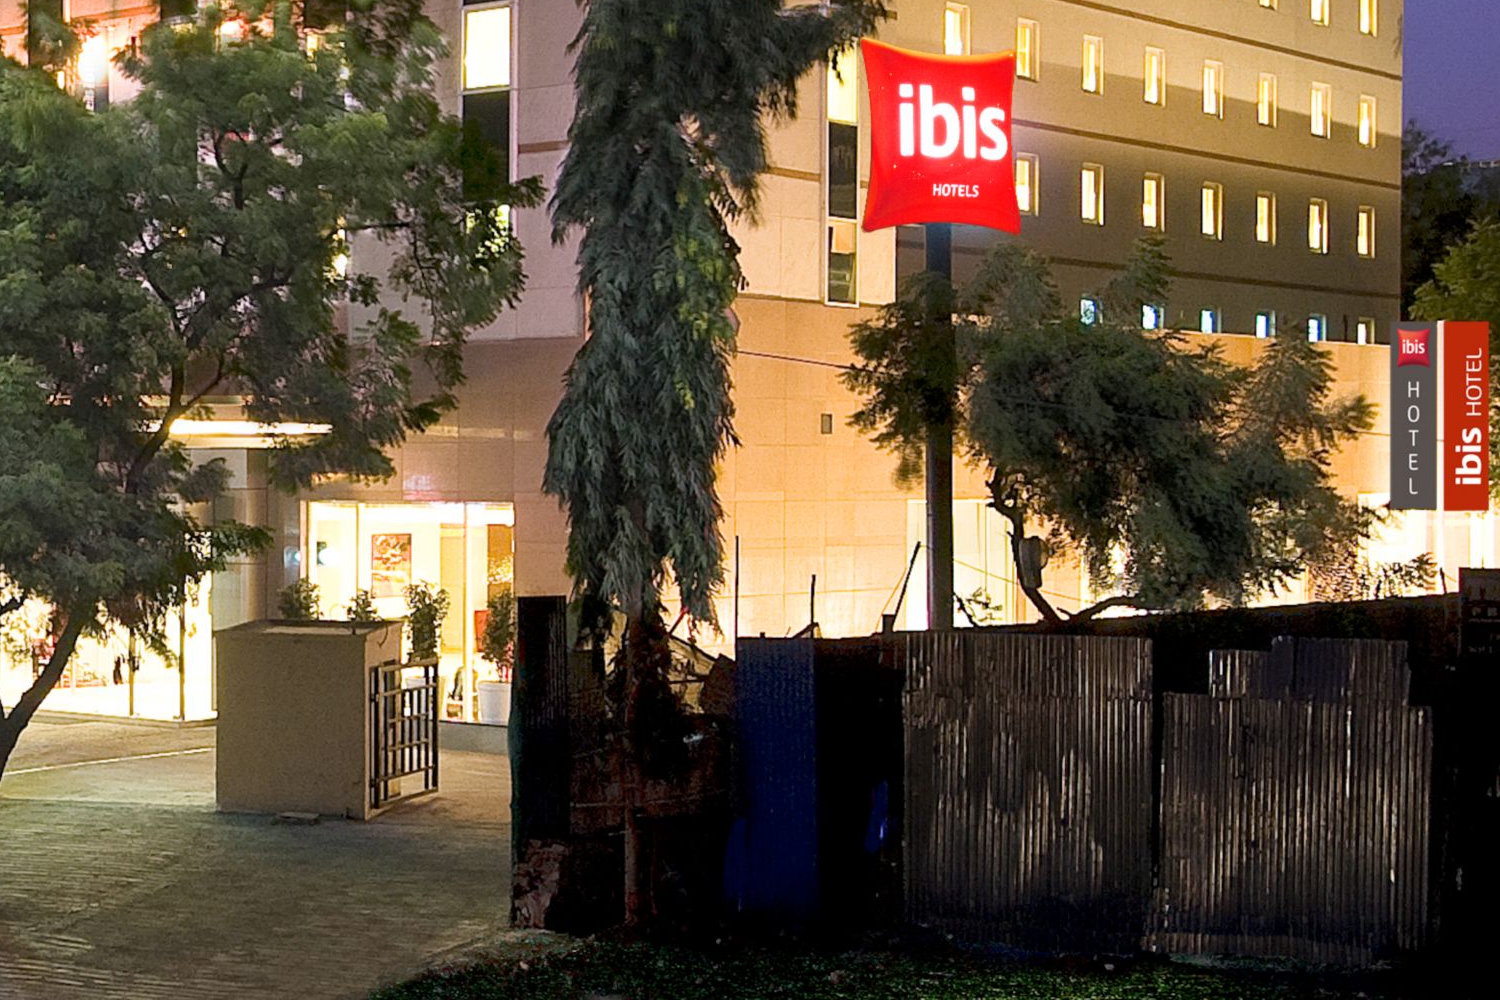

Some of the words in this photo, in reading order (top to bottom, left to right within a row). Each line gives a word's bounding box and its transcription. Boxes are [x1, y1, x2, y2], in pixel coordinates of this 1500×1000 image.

[898, 83, 1009, 161] ibis
[932, 183, 980, 198] HOTELS
[1402, 339, 1426, 355] ibis
[1465, 347, 1483, 416] HOTEL
[1407, 381, 1420, 495] HOTEL
[1455, 427, 1482, 485] ibis
